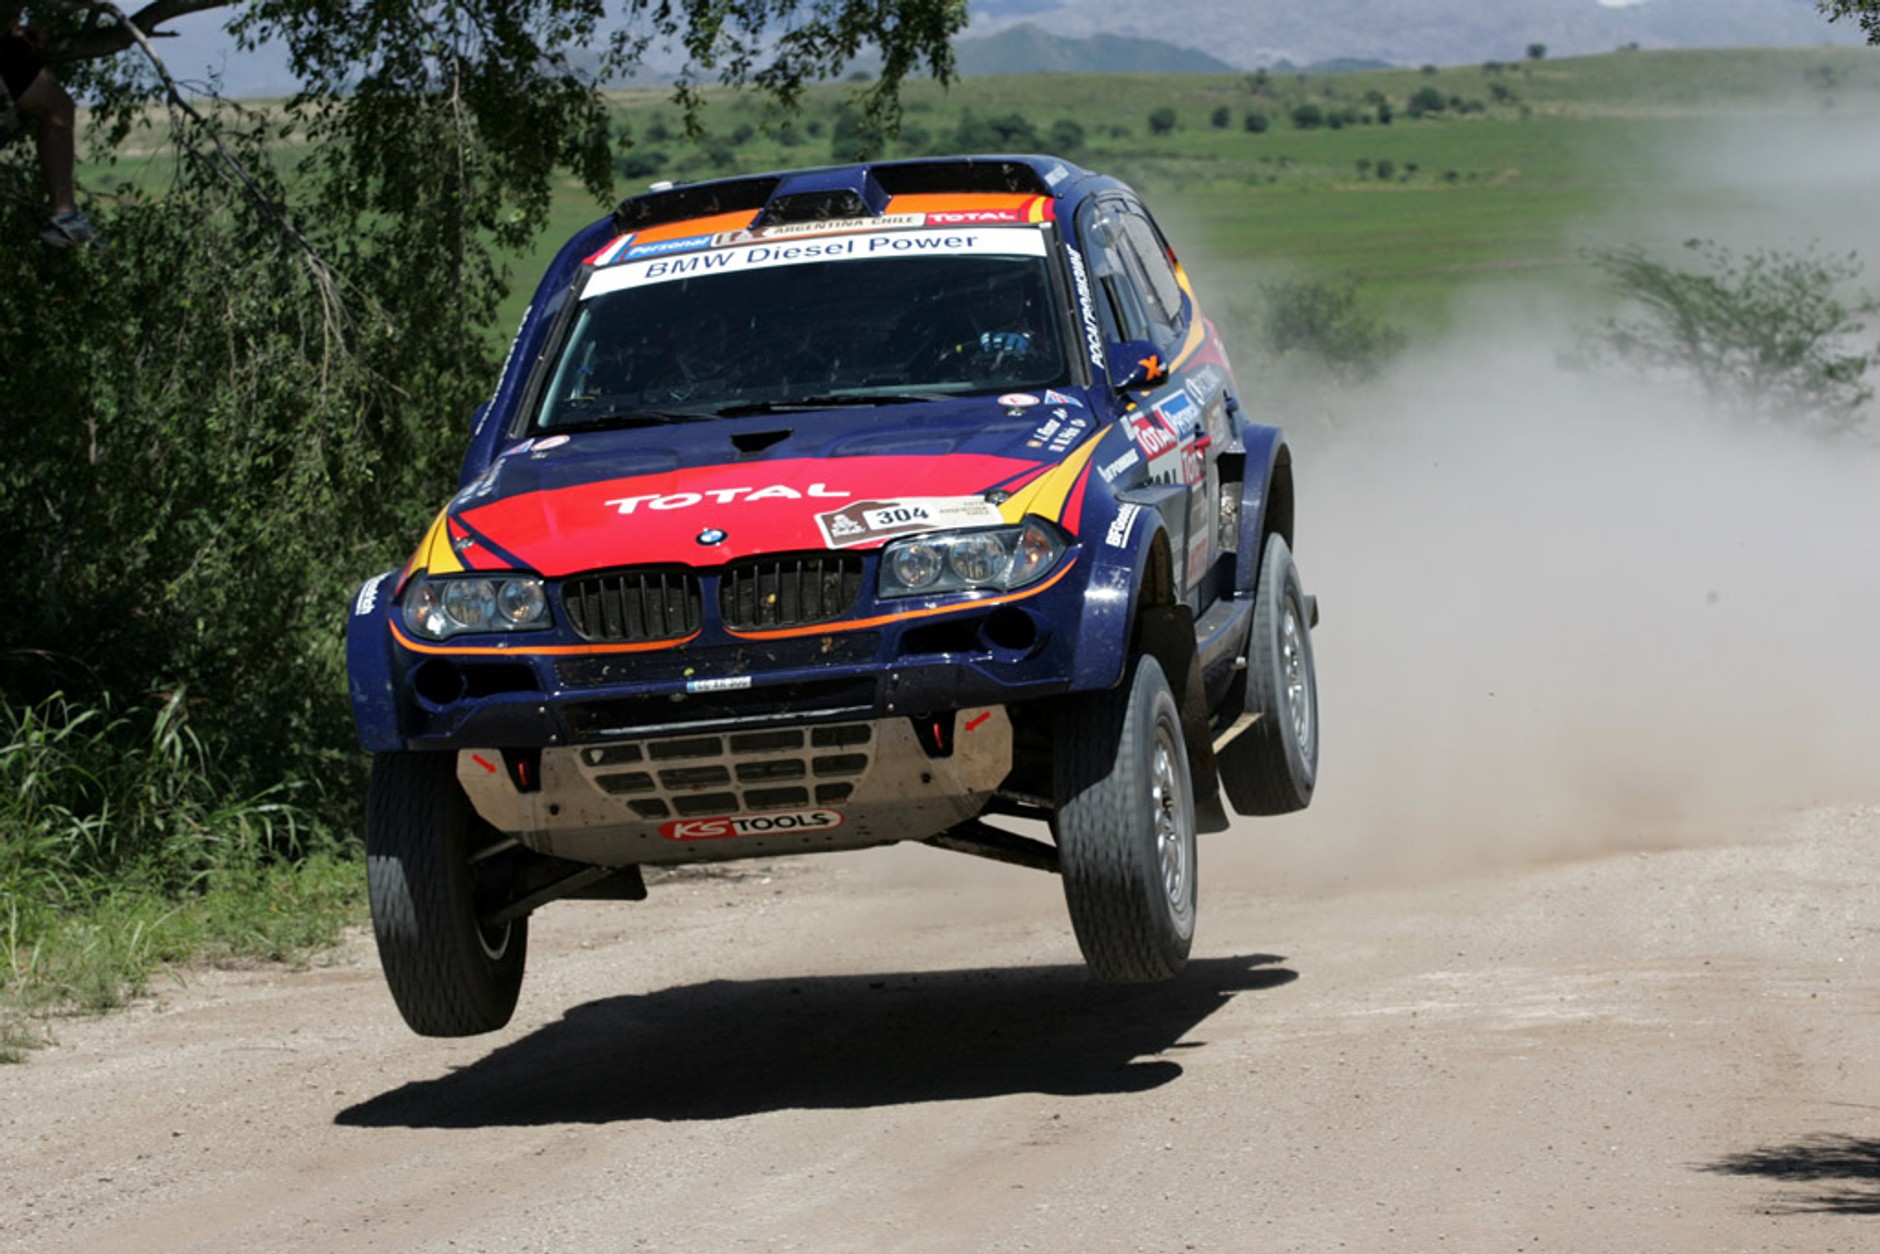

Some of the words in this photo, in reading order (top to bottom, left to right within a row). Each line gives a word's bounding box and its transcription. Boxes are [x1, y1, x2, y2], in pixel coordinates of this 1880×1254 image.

[774, 218, 864, 234] ARGENTINA
[871, 215, 913, 226] CHILE
[928, 211, 1016, 222] TOTAL
[629, 236, 710, 256] Personal
[645, 251, 735, 279] BMW
[746, 240, 854, 263] Diesel
[868, 235, 979, 252] Power
[604, 483, 851, 514] TOTAL
[875, 507, 930, 525] 304
[673, 820, 728, 839] KS
[732, 812, 831, 831] TOOLS
